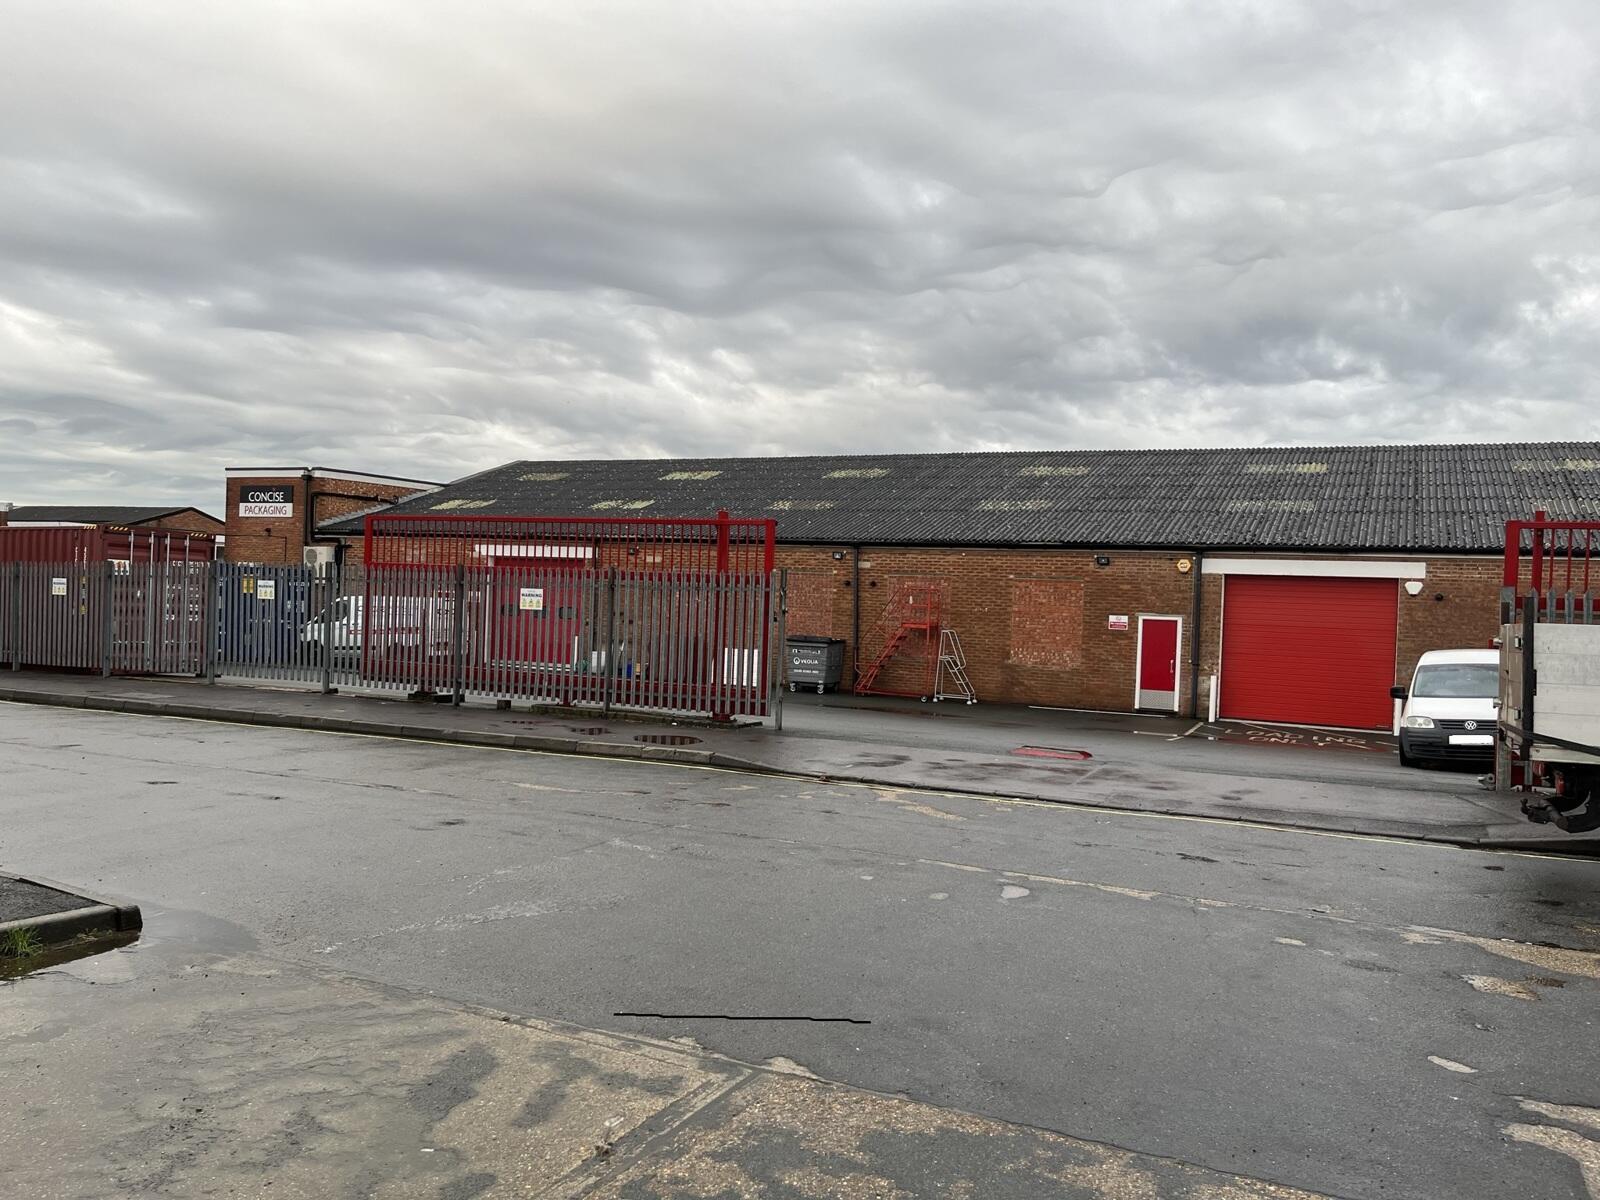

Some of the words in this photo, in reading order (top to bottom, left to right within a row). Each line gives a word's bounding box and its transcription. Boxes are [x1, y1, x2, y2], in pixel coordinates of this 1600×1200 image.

[248, 491, 285, 502] CONCISE
[244, 505, 287, 515] PACKAGING
[1224, 728, 1367, 744] LOADING
[1249, 736, 1332, 746] ONLY
